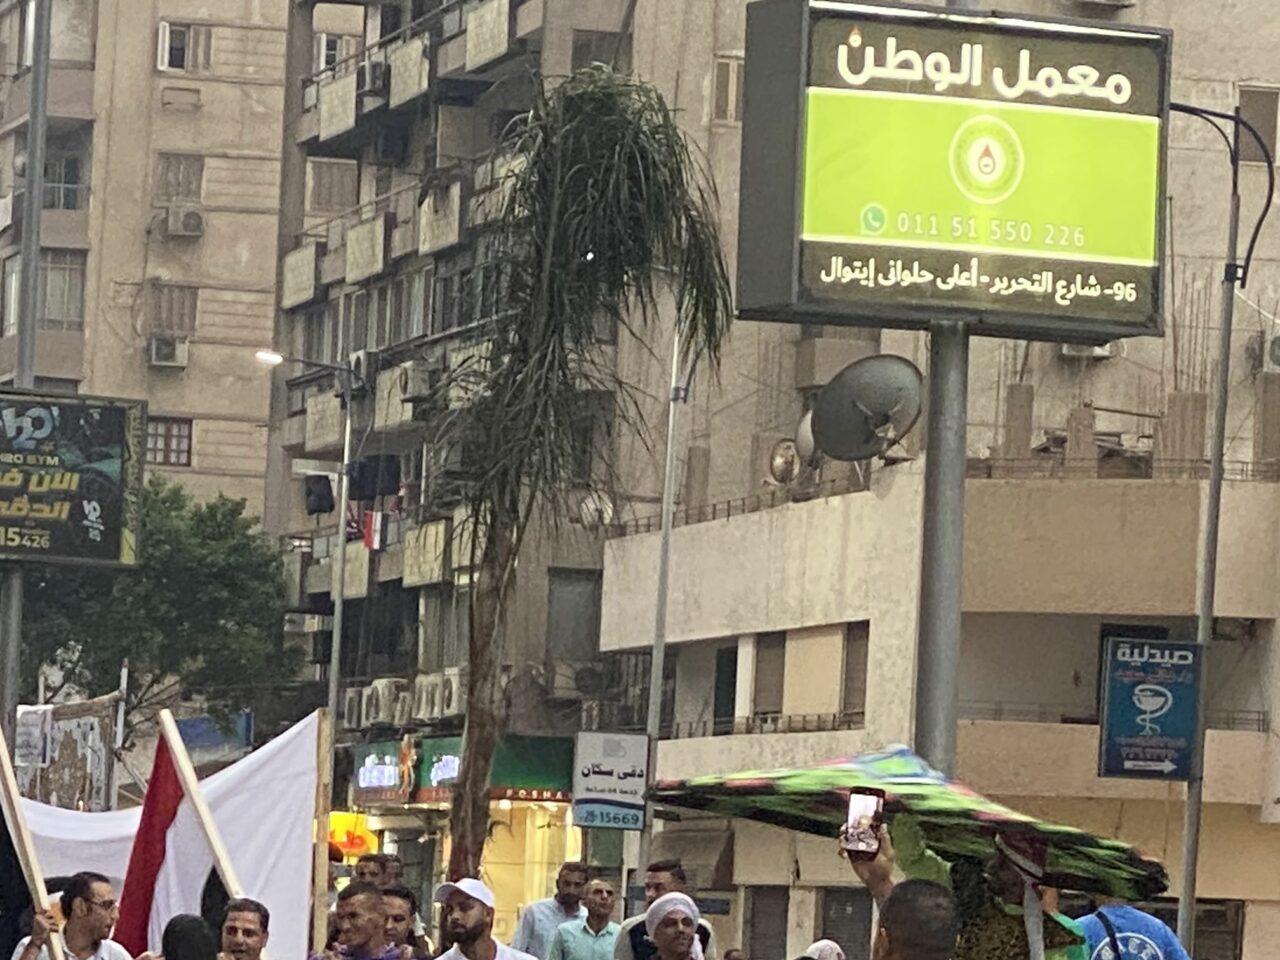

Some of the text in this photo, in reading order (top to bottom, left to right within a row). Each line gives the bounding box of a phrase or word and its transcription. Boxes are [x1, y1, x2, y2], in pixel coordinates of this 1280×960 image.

[837, 27, 1132, 104] معمل الوطن
[897, 212, 1085, 247] 011 51 550 226
[1055, 274, 1101, 304] شارع
[1117, 643, 1194, 667] صيدلية
[581, 763, 614, 778] سكان
